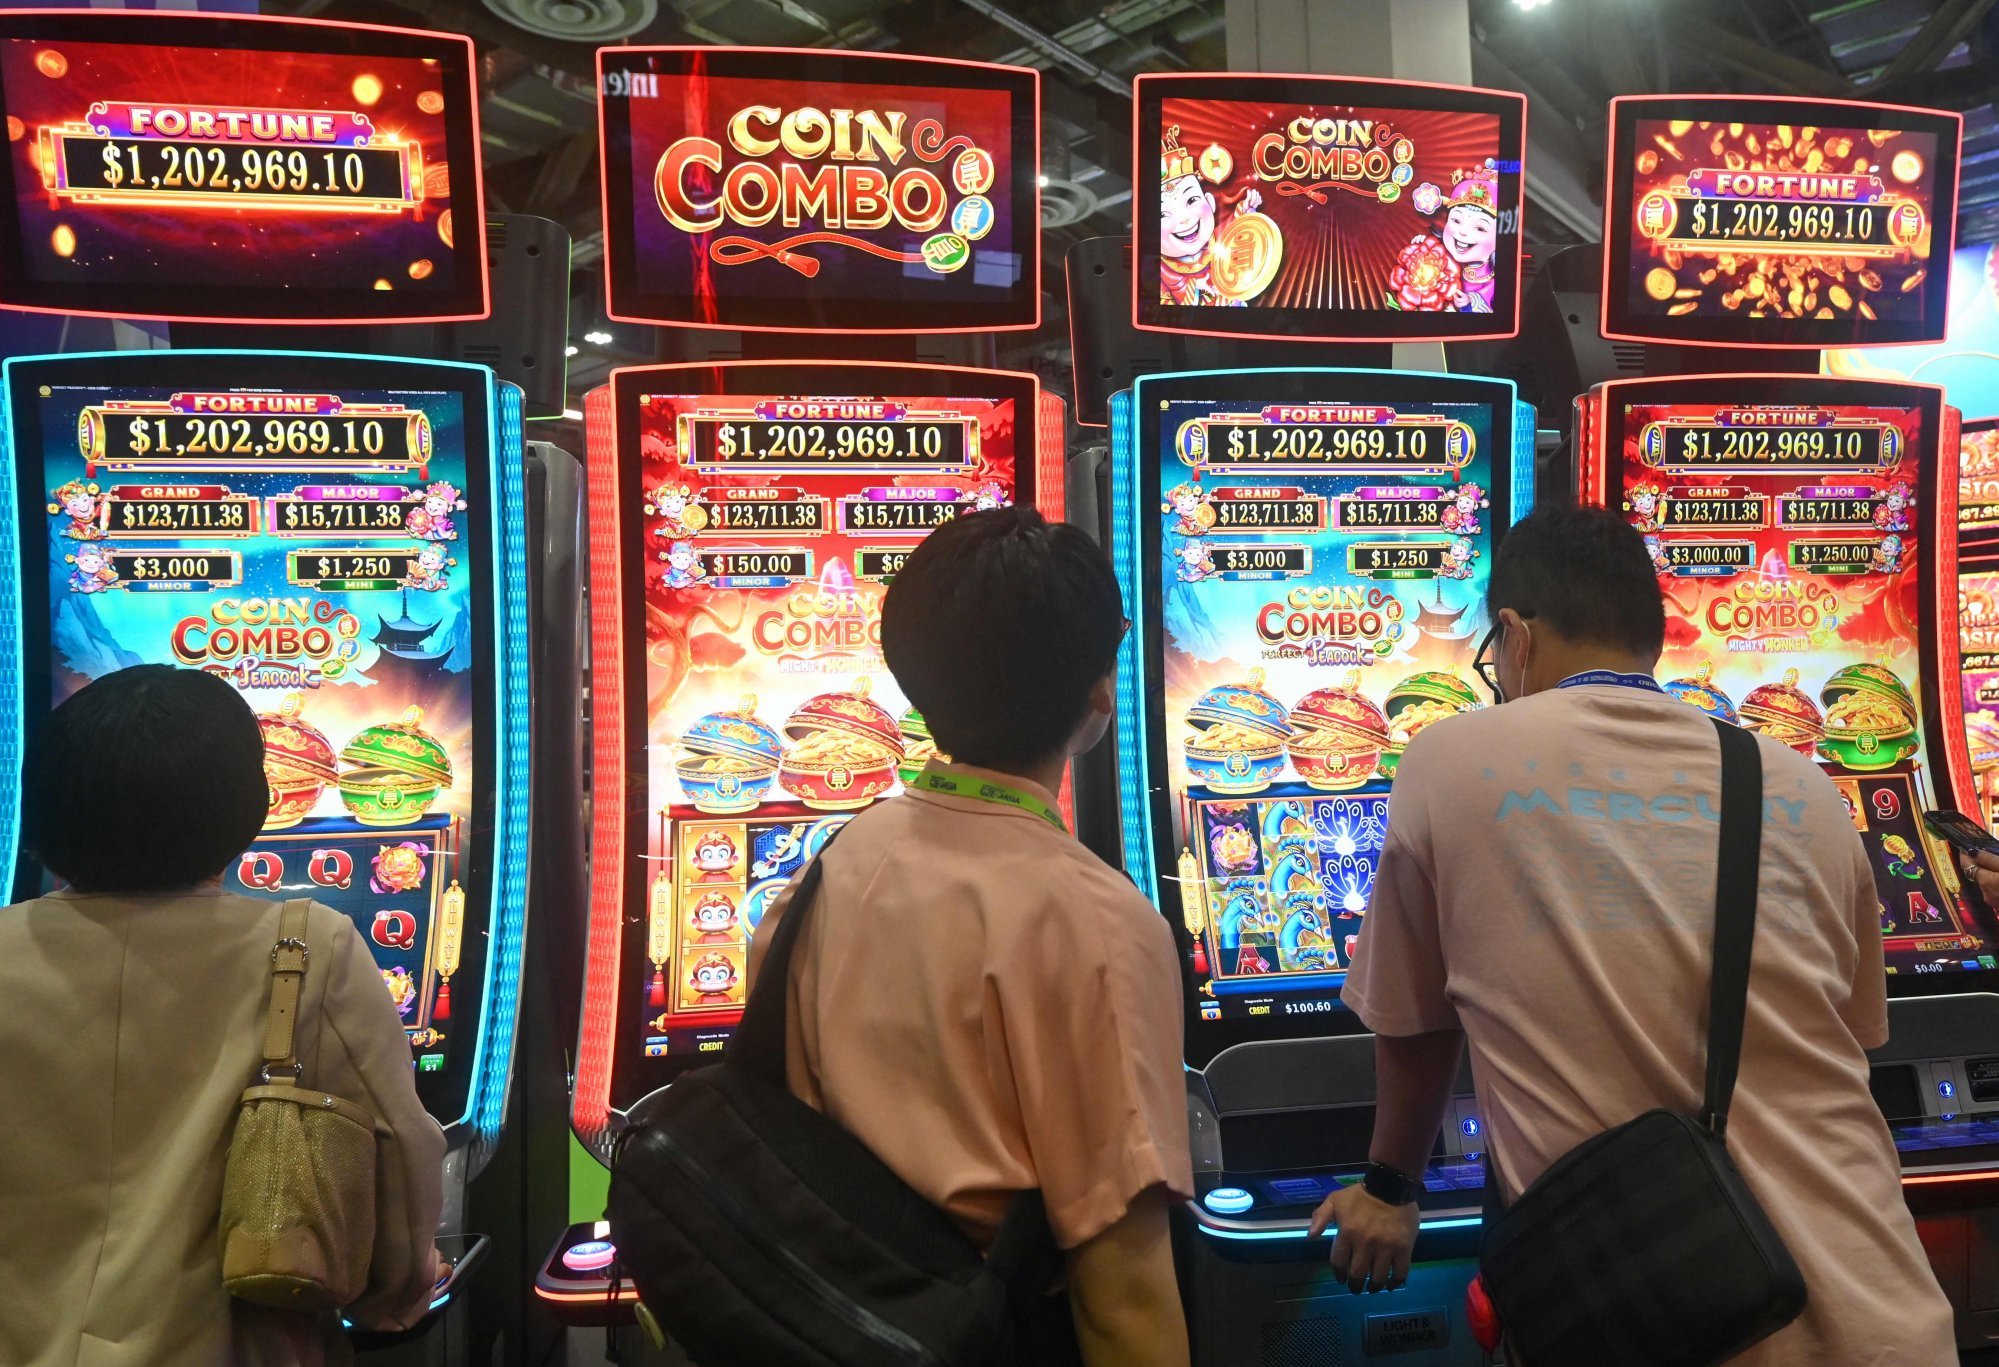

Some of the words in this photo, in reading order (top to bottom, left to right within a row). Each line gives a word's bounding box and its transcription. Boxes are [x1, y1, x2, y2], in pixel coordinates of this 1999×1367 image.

[129, 107, 337, 142] FORTUNE
[727, 104, 907, 165] COIN
[1287, 117, 1373, 147] COIN
[102, 141, 364, 193] $1,202,969.10
[1253, 133, 1391, 182] COMBO
[654, 136, 948, 233] COMBO
[1714, 174, 1857, 200] FORTUNE
[1691, 200, 1873, 239] $1,202,969.10
[193, 396, 318, 413] FORTUNE
[775, 404, 886, 420] FORTUNE
[1279, 408, 1379, 423] FORTUNE
[1731, 412, 1818, 426] FORTUNE
[128, 417, 384, 456] $1,202,969.10
[718, 423, 942, 460] $1,202,969.10
[1227, 427, 1427, 461] $1,202,969.10
[1682, 430, 1863, 462] $1,202,969.10
[140, 487, 201, 500] GRAND
[321, 487, 381, 500] MAJOR
[726, 488, 779, 500] GRAND
[885, 488, 938, 500] MAJOR
[1234, 488, 1281, 499] GRAND
[1375, 487, 1422, 498] MAJOR
[1688, 488, 1729, 498] GRAND
[1815, 487, 1856, 498] MAJOR
[123, 503, 243, 528] $123,711.38
[285, 503, 402, 529] $15,711.38
[710, 504, 816, 528] $123,711.38
[853, 503, 955, 528] $15,711.38
[1220, 502, 1314, 526] $123,711.38
[1347, 502, 1438, 526] $15,711.38
[1675, 500, 1759, 523] $123,711.38
[1788, 500, 1870, 522] $15,711.38
[713, 554, 792, 575] $150.00
[882, 553, 909, 574] $6
[1227, 549, 1286, 570] $3,000
[1371, 548, 1429, 568] $1,250
[1672, 546, 1742, 565] $3,000.00
[1801, 545, 1868, 564] $1,250.00
[133, 555, 209, 578] $3,000
[318, 555, 391, 577] $1,250
[1238, 572, 1273, 581] MINOR
[1391, 570, 1415, 579] MINI
[1689, 566, 1721, 575] MINOR
[1828, 565, 1849, 573] MINI
[147, 581, 192, 592] MINOR
[345, 580, 374, 590] MINI
[732, 577, 771, 586] MINOR
[1735, 579, 1803, 603] COIN
[787, 591, 875, 618] COIN
[1287, 586, 1366, 610] COIN
[211, 598, 311, 626] COIN
[1706, 596, 1819, 636] COMBO
[1256, 602, 1383, 645] COMBO
[171, 616, 334, 665] COMBO
[1262, 649, 1306, 660] PERFECT
[1872, 788, 1901, 820] 9
[238, 851, 284, 891] Q
[308, 849, 354, 890] Q
[1907, 891, 1943, 924] A
[371, 910, 417, 950] Q
[1914, 963, 1943, 974] $0.00
[1249, 1006, 1270, 1015] CREDIT
[1285, 1001, 1331, 1015] $100.60
[699, 1042, 724, 1051] CREDIT
[1383, 1318, 1418, 1332] LIGHT
[1380, 1329, 1436, 1345] WONDER
